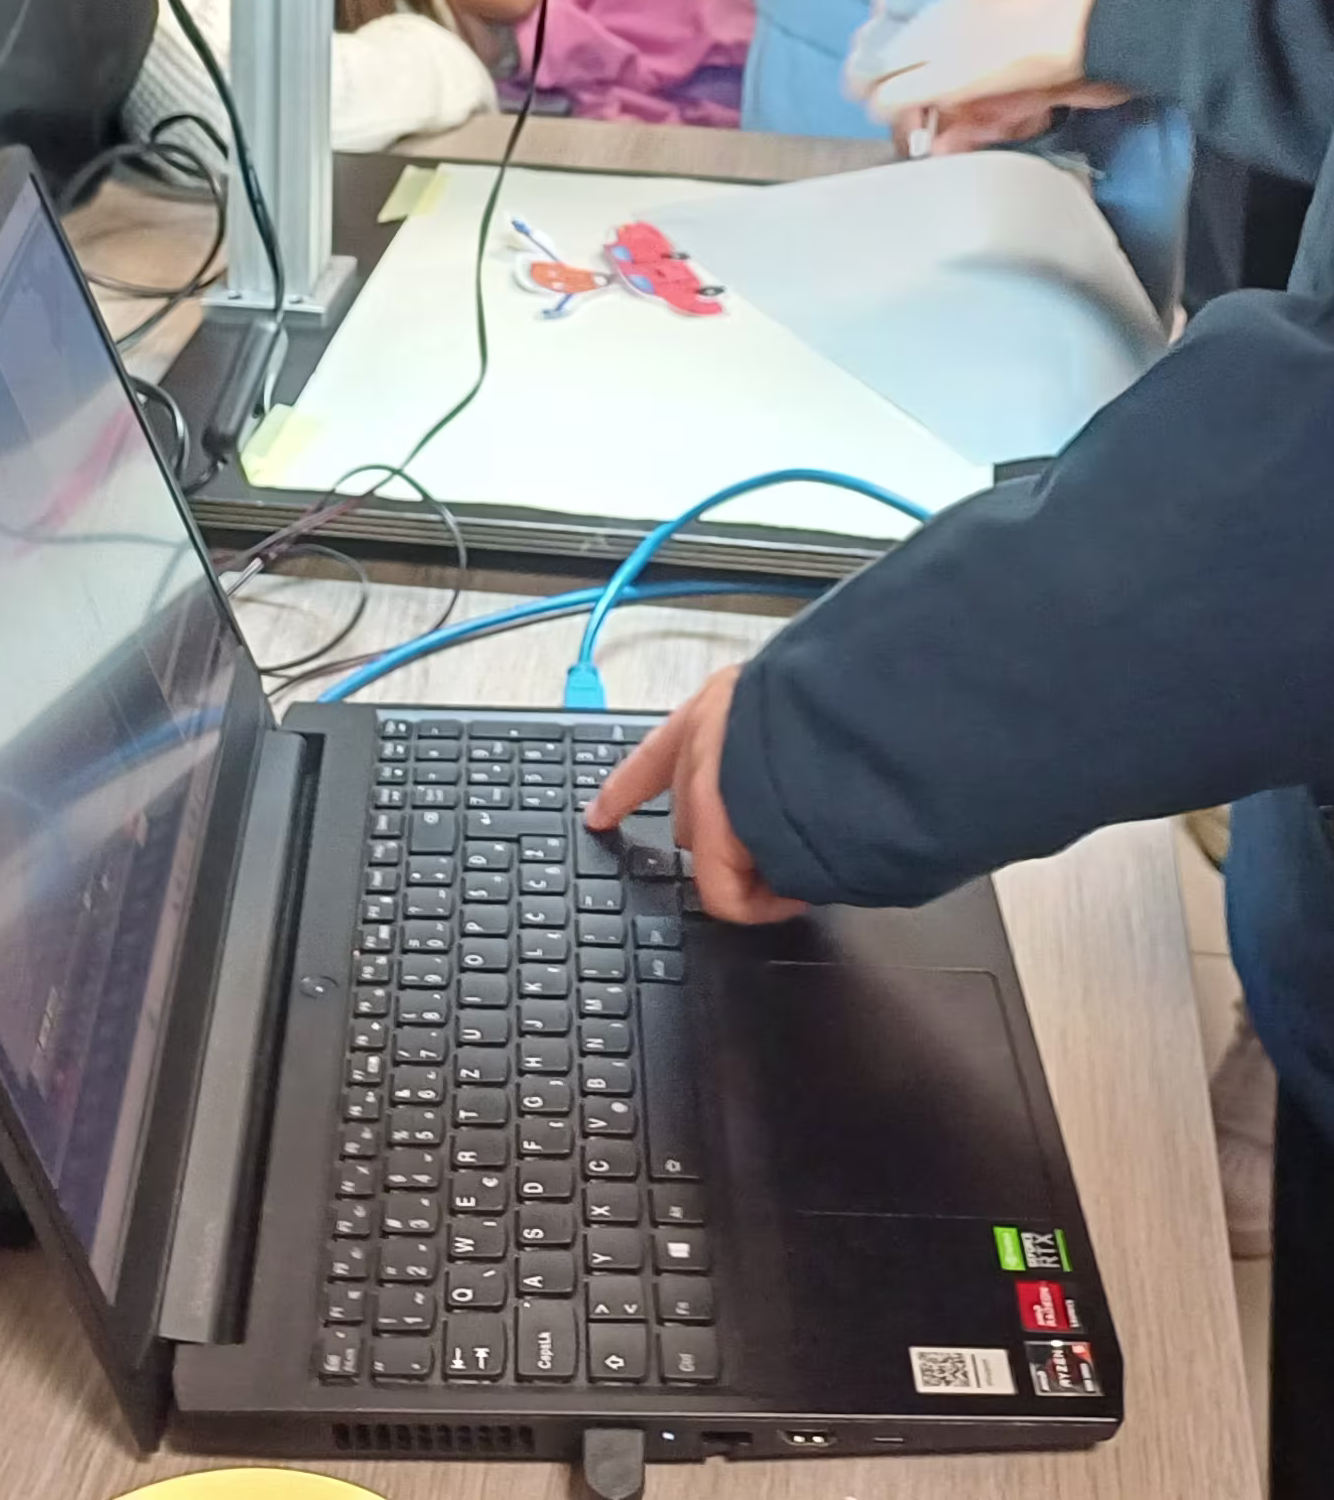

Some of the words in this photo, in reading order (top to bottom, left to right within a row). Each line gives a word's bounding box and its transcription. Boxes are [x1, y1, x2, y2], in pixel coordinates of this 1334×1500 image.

[524, 948, 543, 957] L
[464, 954, 484, 965] O
[525, 982, 543, 992] K
[584, 999, 603, 1010] M
[524, 1020, 543, 1028] J
[462, 1029, 481, 1039] U
[586, 1038, 605, 1048] N
[419, 1050, 437, 1058] 7
[524, 1057, 543, 1067] H
[460, 1068, 480, 1078] Z
[587, 1078, 606, 1088] B
[417, 1090, 436, 1098] 6
[523, 1096, 544, 1108] G
[459, 1110, 479, 1118] T
[588, 1118, 607, 1128] V
[523, 1140, 543, 1150] F
[456, 1151, 477, 1162] R
[588, 1160, 609, 1172] C
[523, 1182, 543, 1193] D
[455, 1196, 476, 1207] E
[590, 1205, 611, 1216] X
[523, 1228, 544, 1239] S
[454, 1237, 475, 1252] W
[1034, 1233, 1060, 1267] RTX
[592, 1252, 613, 1263] Y
[407, 1265, 427, 1276] 2
[523, 1275, 543, 1288] A
[451, 1288, 473, 1301] Q
[537, 1332, 554, 1369] CapsLk
[1053, 1349, 1072, 1387] RYZEN
